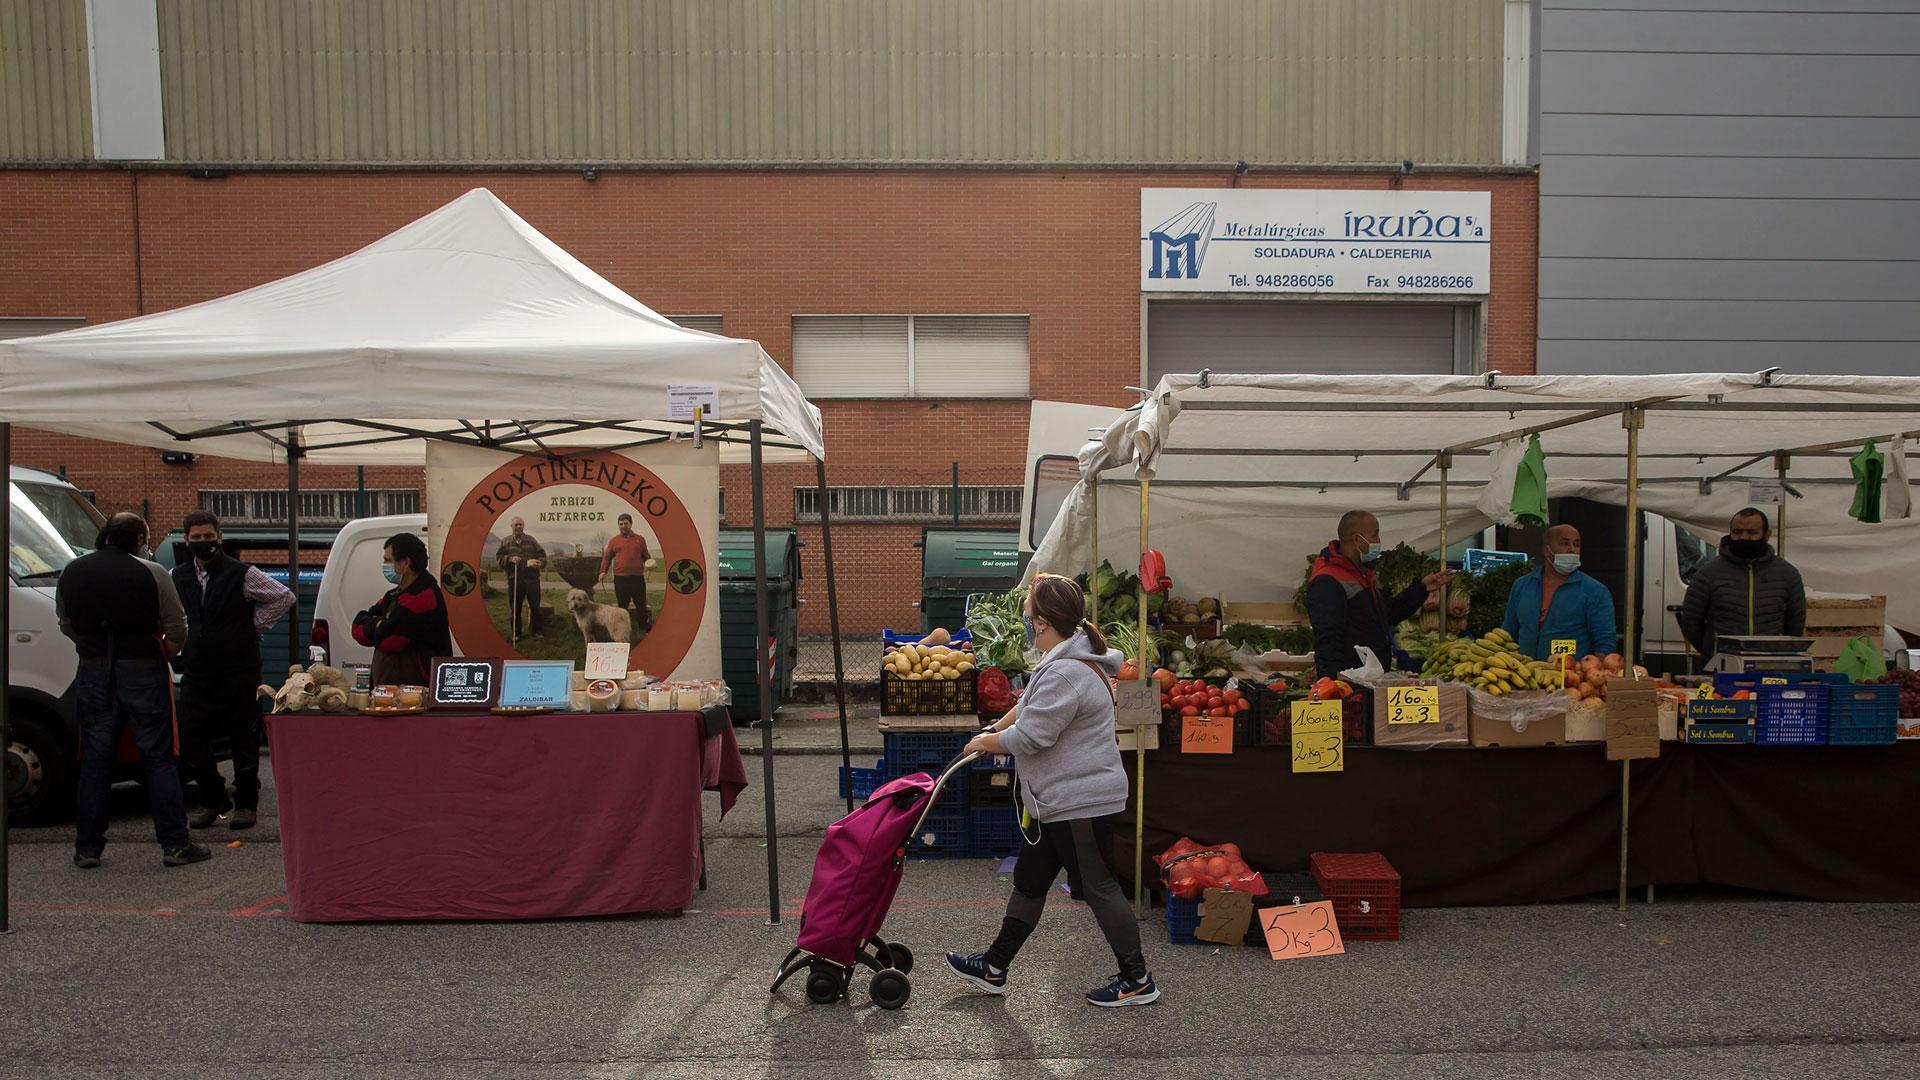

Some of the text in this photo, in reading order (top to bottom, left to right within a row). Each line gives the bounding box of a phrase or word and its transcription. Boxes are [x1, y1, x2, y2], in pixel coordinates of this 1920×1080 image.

[1223, 222, 1326, 239] Metalúrgicas
[1254, 248, 1432, 259] SOLDADURA CALDERERIA
[1229, 274, 1334, 287] Tel. 948286056
[1367, 276, 1473, 288] Fax 948286266
[540, 511, 605, 521] NAFARROA
